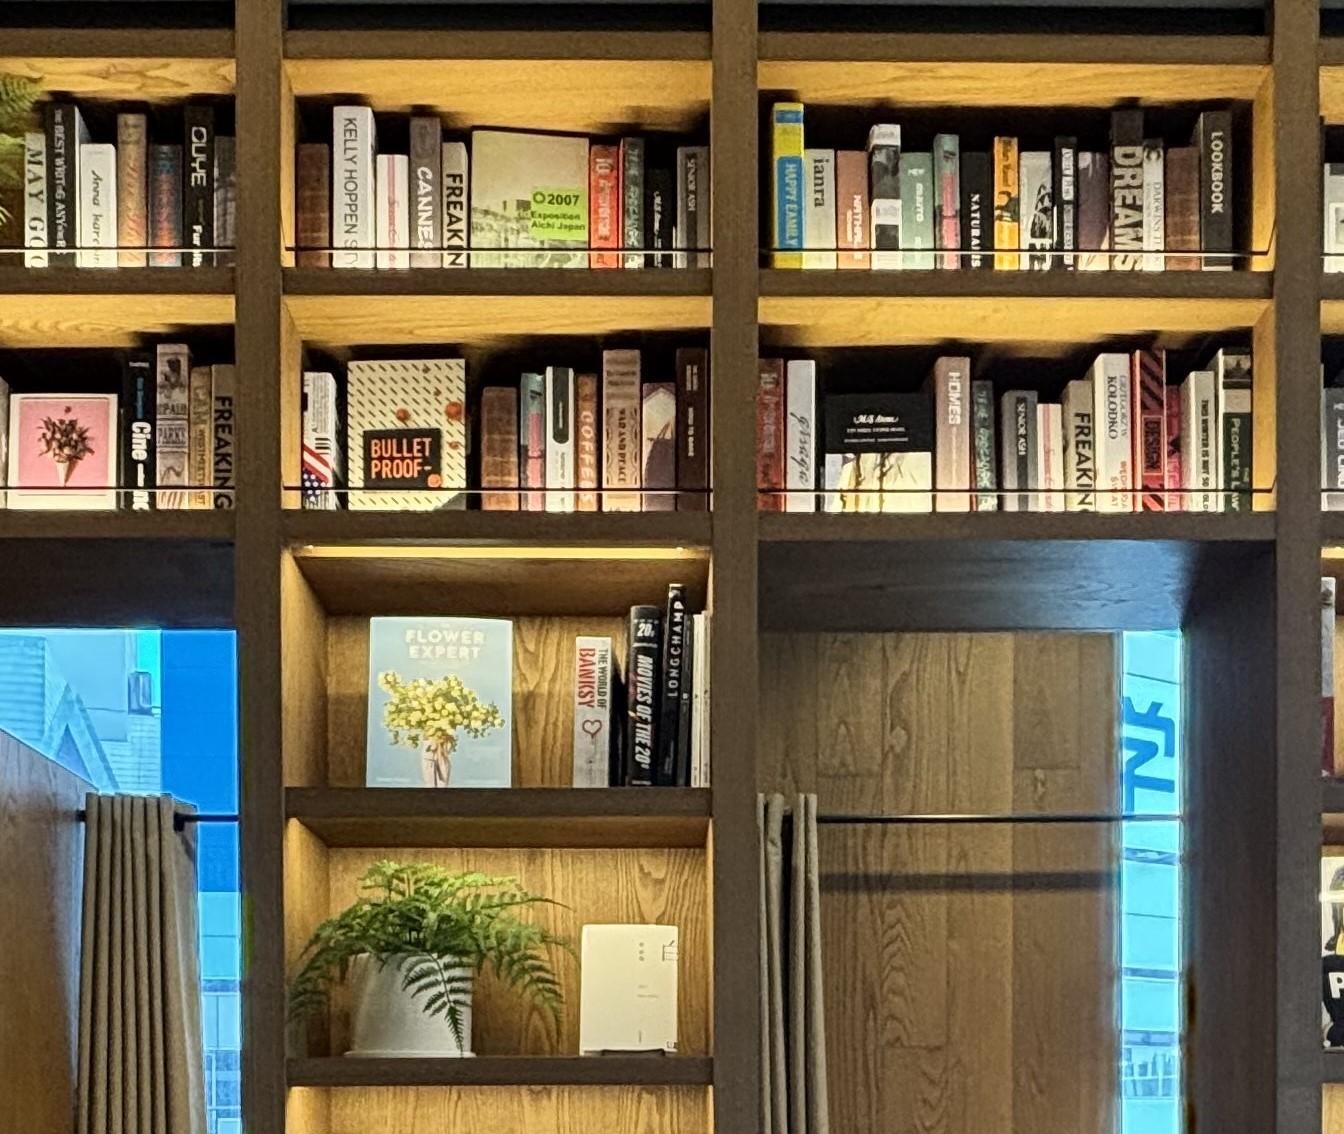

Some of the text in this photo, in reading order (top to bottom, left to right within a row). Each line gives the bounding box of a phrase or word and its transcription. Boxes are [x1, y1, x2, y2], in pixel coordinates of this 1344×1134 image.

[28, 147, 44, 204] MAY
[343, 117, 358, 234] KELLY HOPPEN
[813, 157, 830, 208] ianra
[1210, 131, 1224, 214] LOOKBOOK
[547, 194, 580, 206] 2007
[948, 371, 961, 424] HOMES
[131, 421, 152, 461] Cine
[369, 437, 432, 459] BULLET
[404, 629, 486, 644] FLOWER
[408, 644, 482, 660] EXPERT
[667, 600, 685, 697] LONGCHAMP
[577, 647, 598, 709] BANKSY
[634, 654, 654, 747] MOVIES OF THE
